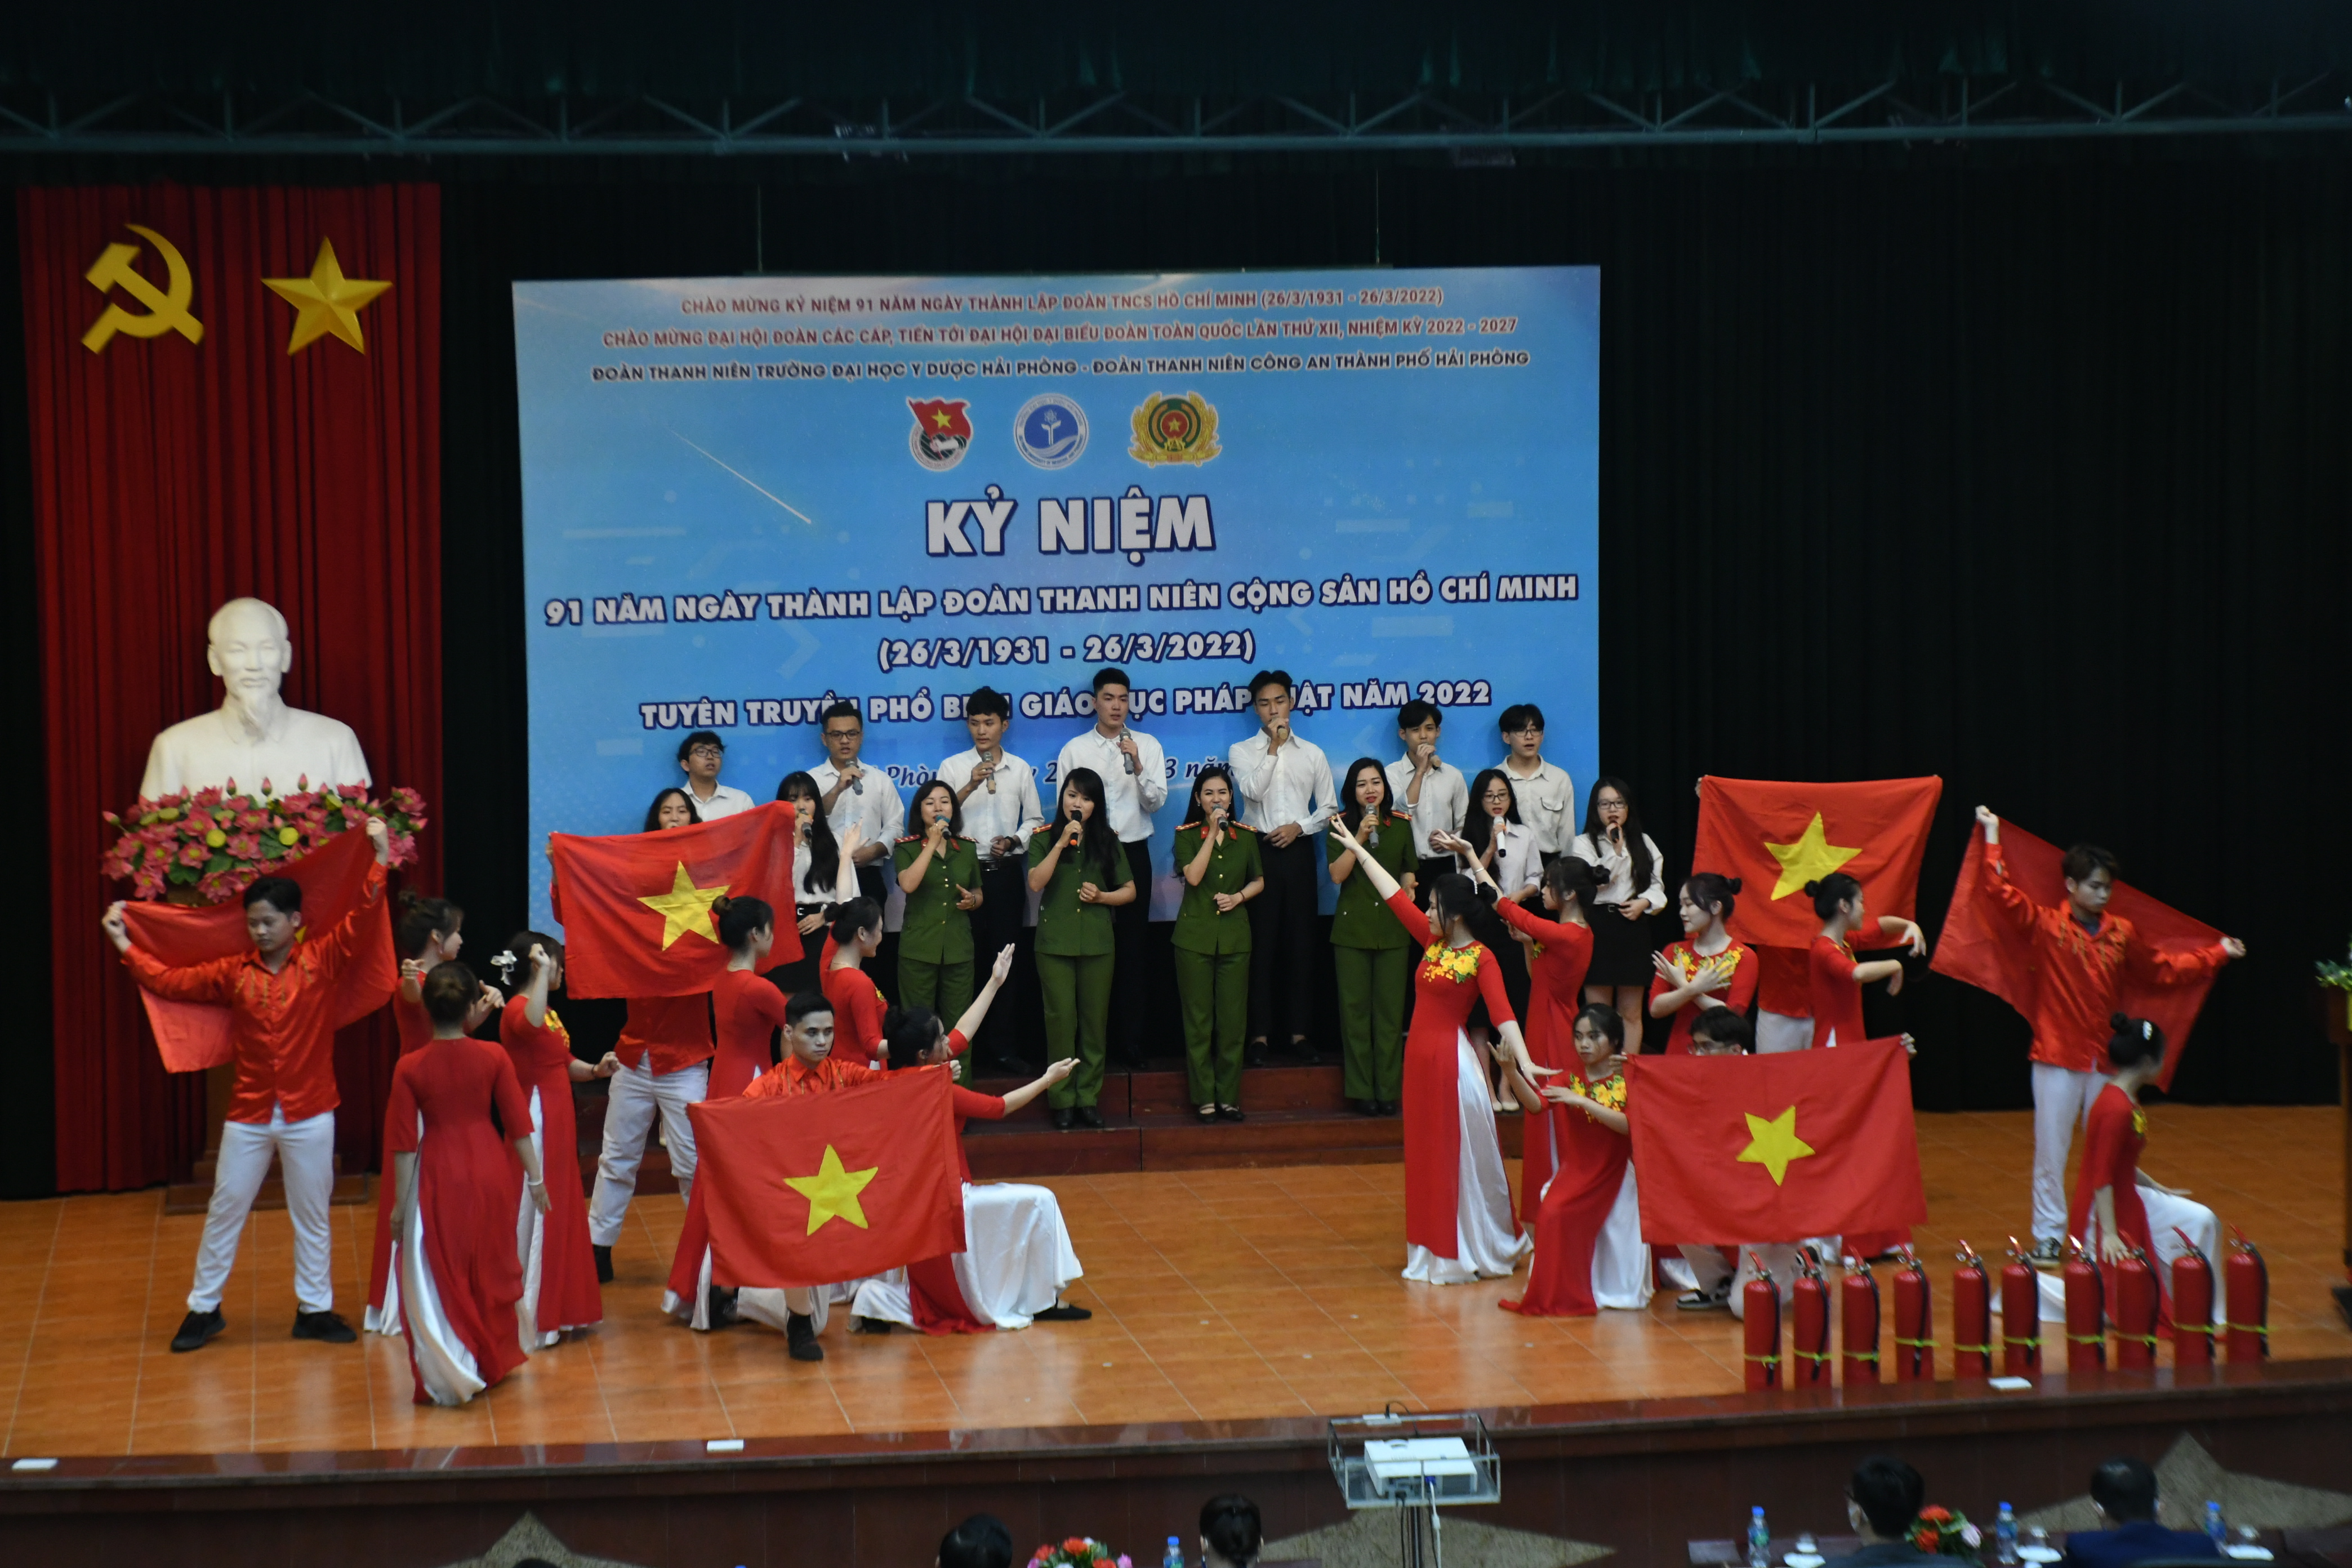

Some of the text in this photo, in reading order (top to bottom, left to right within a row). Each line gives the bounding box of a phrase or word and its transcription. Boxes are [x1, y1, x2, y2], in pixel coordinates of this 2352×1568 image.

[681, 297, 727, 314] CHÀO
[732, 297, 780, 313] MỪNG
[812, 296, 850, 315] NIỆM
[856, 297, 874, 312] 91
[880, 293, 916, 311] NĂM
[921, 294, 963, 311] NGÀY
[968, 293, 1023, 311] THÀNH
[1028, 292, 1058, 314] LẬP
[1063, 291, 1106, 310] ĐOÀN
[1111, 294, 1152, 309] TNCS
[1157, 290, 1179, 308] HỒ
[1184, 289, 1211, 308] CHÍ
[1215, 291, 1257, 308] MINH
[1261, 290, 1343, 309] (26/3/1931
[1360, 287, 1444, 306] 26/3/2022)
[603, 327, 649, 347] CHÀO
[653, 327, 703, 347] MỪNG
[707, 330, 734, 349] ĐẠI
[739, 327, 768, 349] HỘI
[772, 327, 818, 345] ĐOÀN
[822, 327, 856, 345] CÁC
[859, 324, 894, 347] CẤP,
[898, 323, 934, 344] TIẾN
[938, 323, 965, 342] TỚI
[969, 327, 997, 345] ĐẠI
[1001, 323, 1028, 346] HỘI
[1033, 327, 1059, 346] ĐẠI
[1104, 321, 1148, 340] ĐOÀN
[1152, 320, 1195, 340] TOÀN
[1199, 319, 1242, 340] QUỐC
[1246, 318, 1277, 338] LẦN
[1319, 320, 1344, 340] XII,
[1347, 317, 1398, 338] NHIỆM
[1427, 318, 1464, 334] 2022
[1479, 317, 1518, 333] 2027
[592, 362, 644, 382] ĐOÀN
[648, 365, 707, 381] THANH
[712, 360, 751, 379] NIÊN
[756, 359, 827, 379] TRƯỜNG
[831, 363, 862, 382] ĐẠI
[867, 362, 907, 381] HỌC
[911, 362, 923, 376] Y
[927, 359, 977, 381] DƯỢC
[982, 356, 1012, 376] HẢI
[1017, 357, 1077, 375] PHÒNG
[1092, 354, 1142, 374] ĐOÀN
[1147, 357, 1202, 373] THANH
[1208, 353, 1245, 372] NIÊN
[1250, 352, 1302, 370] CÔNG
[1307, 355, 1331, 369] AN
[1335, 349, 1391, 368] THÀNH
[1395, 346, 1432, 367] PHỐ
[1435, 348, 1464, 367] HẢI
[1468, 347, 1530, 366] PHÒNG
[926, 483, 1216, 567] KỶ NIỆM
[545, 569, 1579, 627] 91 NĂM NGÀY THÀNH LẬP ĐOÀN THANH NIÊN CỘNG SẢN HỒ CHÍ MINH
[877, 636, 1049, 674] (26/3/1931
[1084, 629, 1255, 664] 26/3/2022)
[639, 696, 738, 729] TUYÊN
[868, 686, 934, 723] PHỔ
[1019, 686, 1095, 720] GIÁO
[1128, 688, 1167, 721] ỤC
[1173, 681, 1252, 715] PHÁP
[1290, 679, 1335, 716] ẬT
[1341, 678, 1411, 710] NĂM
[1417, 679, 1491, 706] 2022
